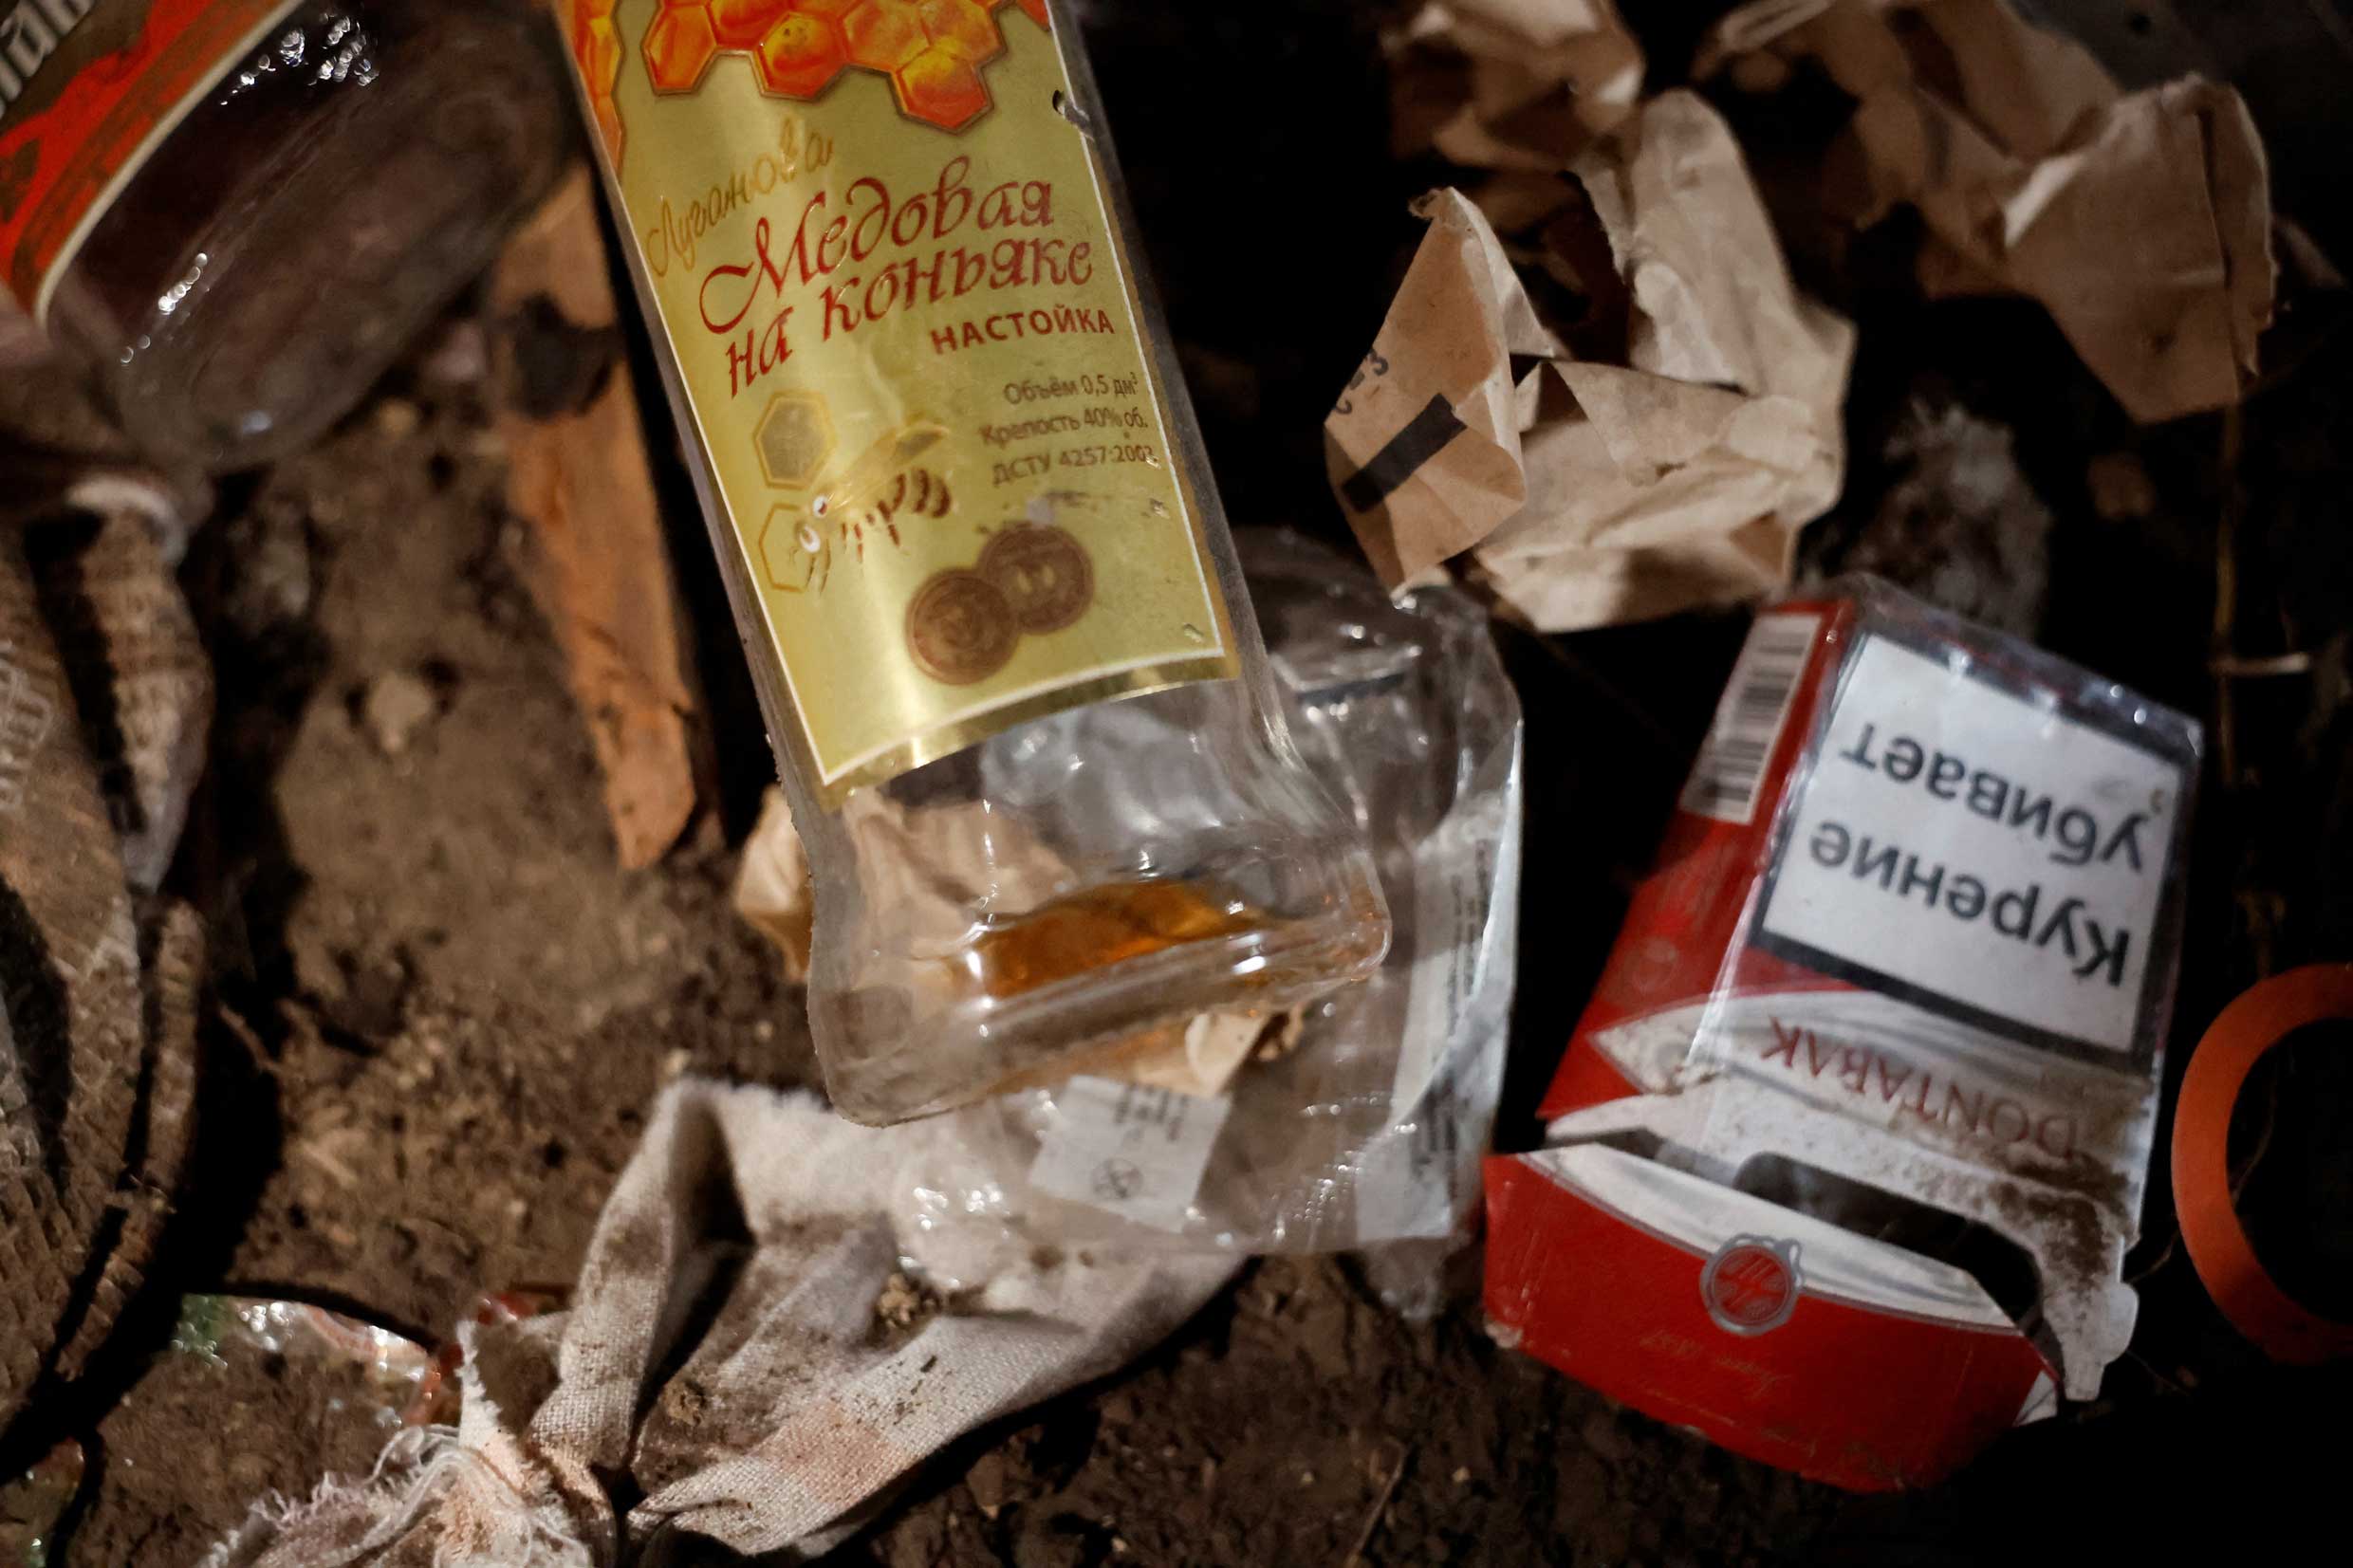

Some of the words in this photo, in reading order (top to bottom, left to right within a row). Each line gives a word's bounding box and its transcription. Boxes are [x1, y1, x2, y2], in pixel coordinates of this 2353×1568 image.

[698, 155, 1054, 335] Медовая
[726, 305, 794, 398] на
[818, 235, 1093, 342] коньяке
[930, 304, 1117, 355] НАСТОЙКА
[1080, 374, 1109, 397] 0,5
[978, 414, 1082, 449] Крепость
[1084, 406, 1123, 428] 40%
[1123, 406, 1149, 428] об.
[992, 452, 1050, 488] ДСТУ
[1839, 722, 2149, 874] убивает
[1809, 820, 2131, 987] Курение
[1760, 1016, 2078, 1161] DONTABAK
